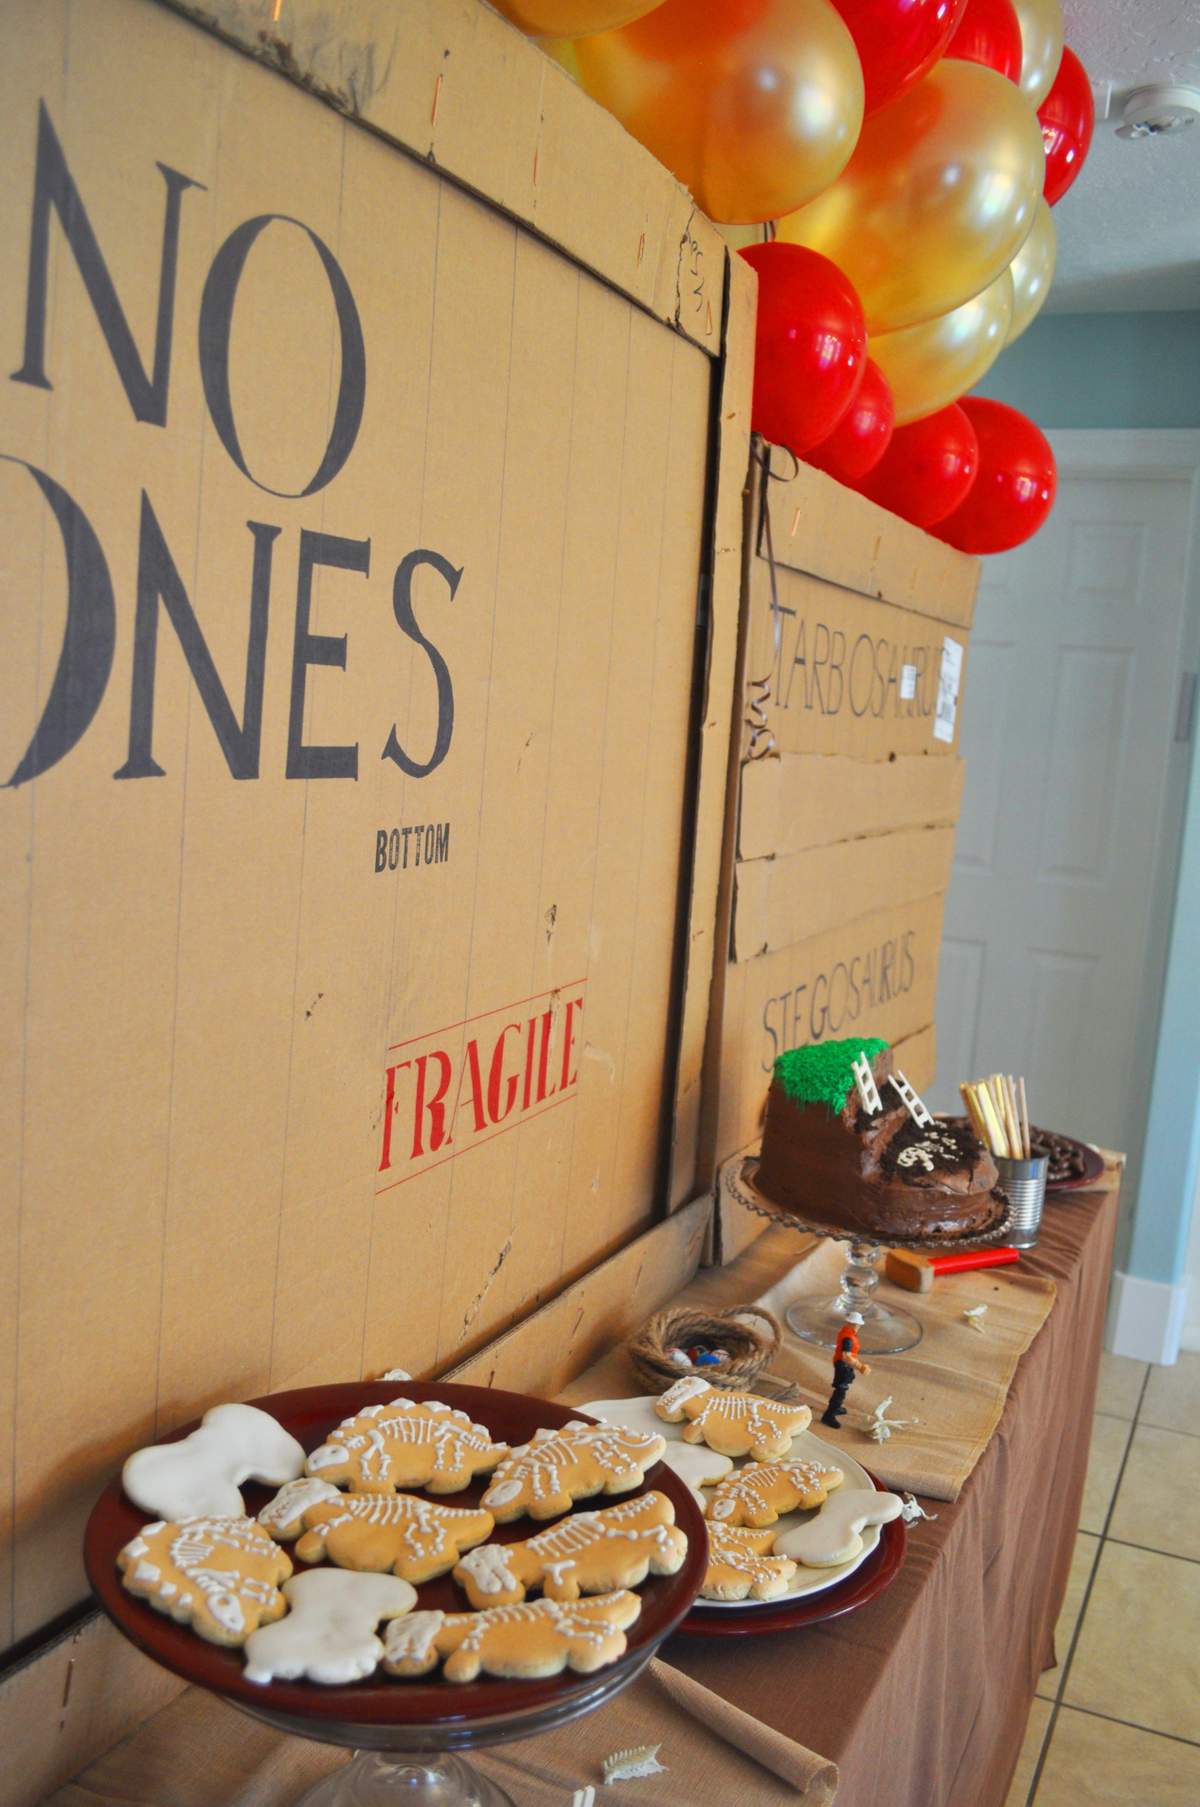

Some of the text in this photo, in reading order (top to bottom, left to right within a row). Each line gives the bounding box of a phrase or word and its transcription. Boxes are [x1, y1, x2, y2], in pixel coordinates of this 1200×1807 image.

[9, 97, 366, 498] NO
[374, 822, 450, 873] BOTTOM
[378, 997, 584, 1172] FRAGILE
